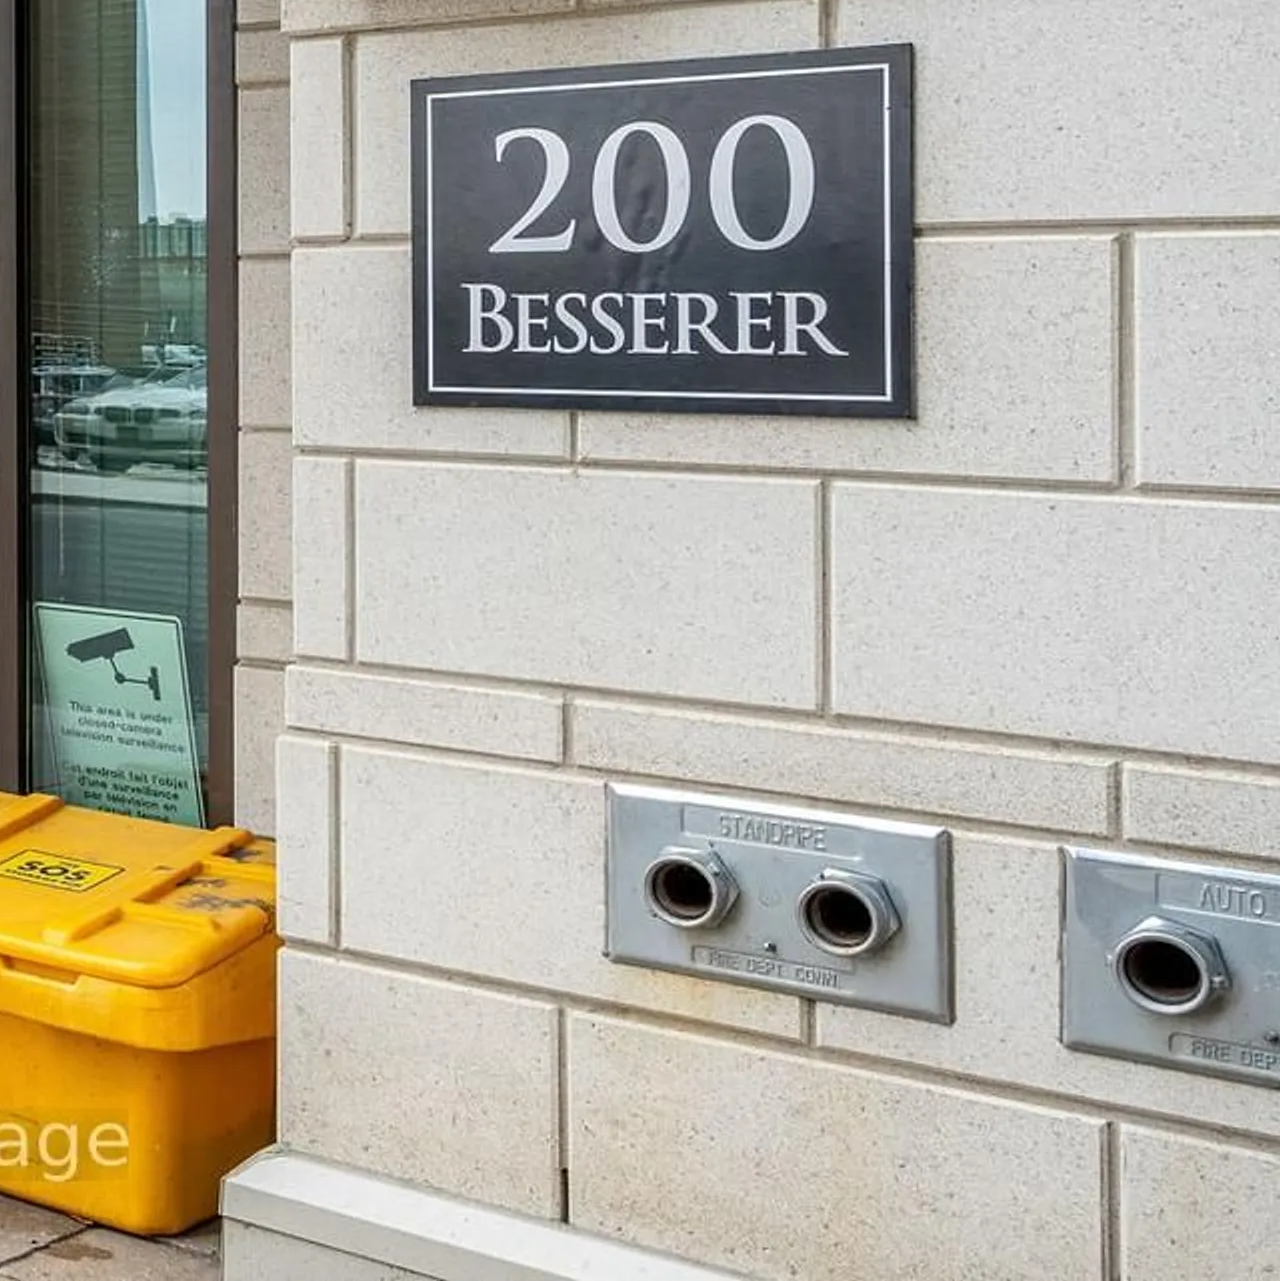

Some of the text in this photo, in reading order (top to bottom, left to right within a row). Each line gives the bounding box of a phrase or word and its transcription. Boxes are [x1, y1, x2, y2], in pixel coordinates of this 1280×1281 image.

[488, 114, 816, 255] 200
[460, 282, 850, 358] BESSERER
[720, 814, 828, 851] STANDPIPE
[17, 860, 92, 882] SOS
[1200, 882, 1266, 918] AUTO
[1240, 1050, 1280, 1071] DEP
